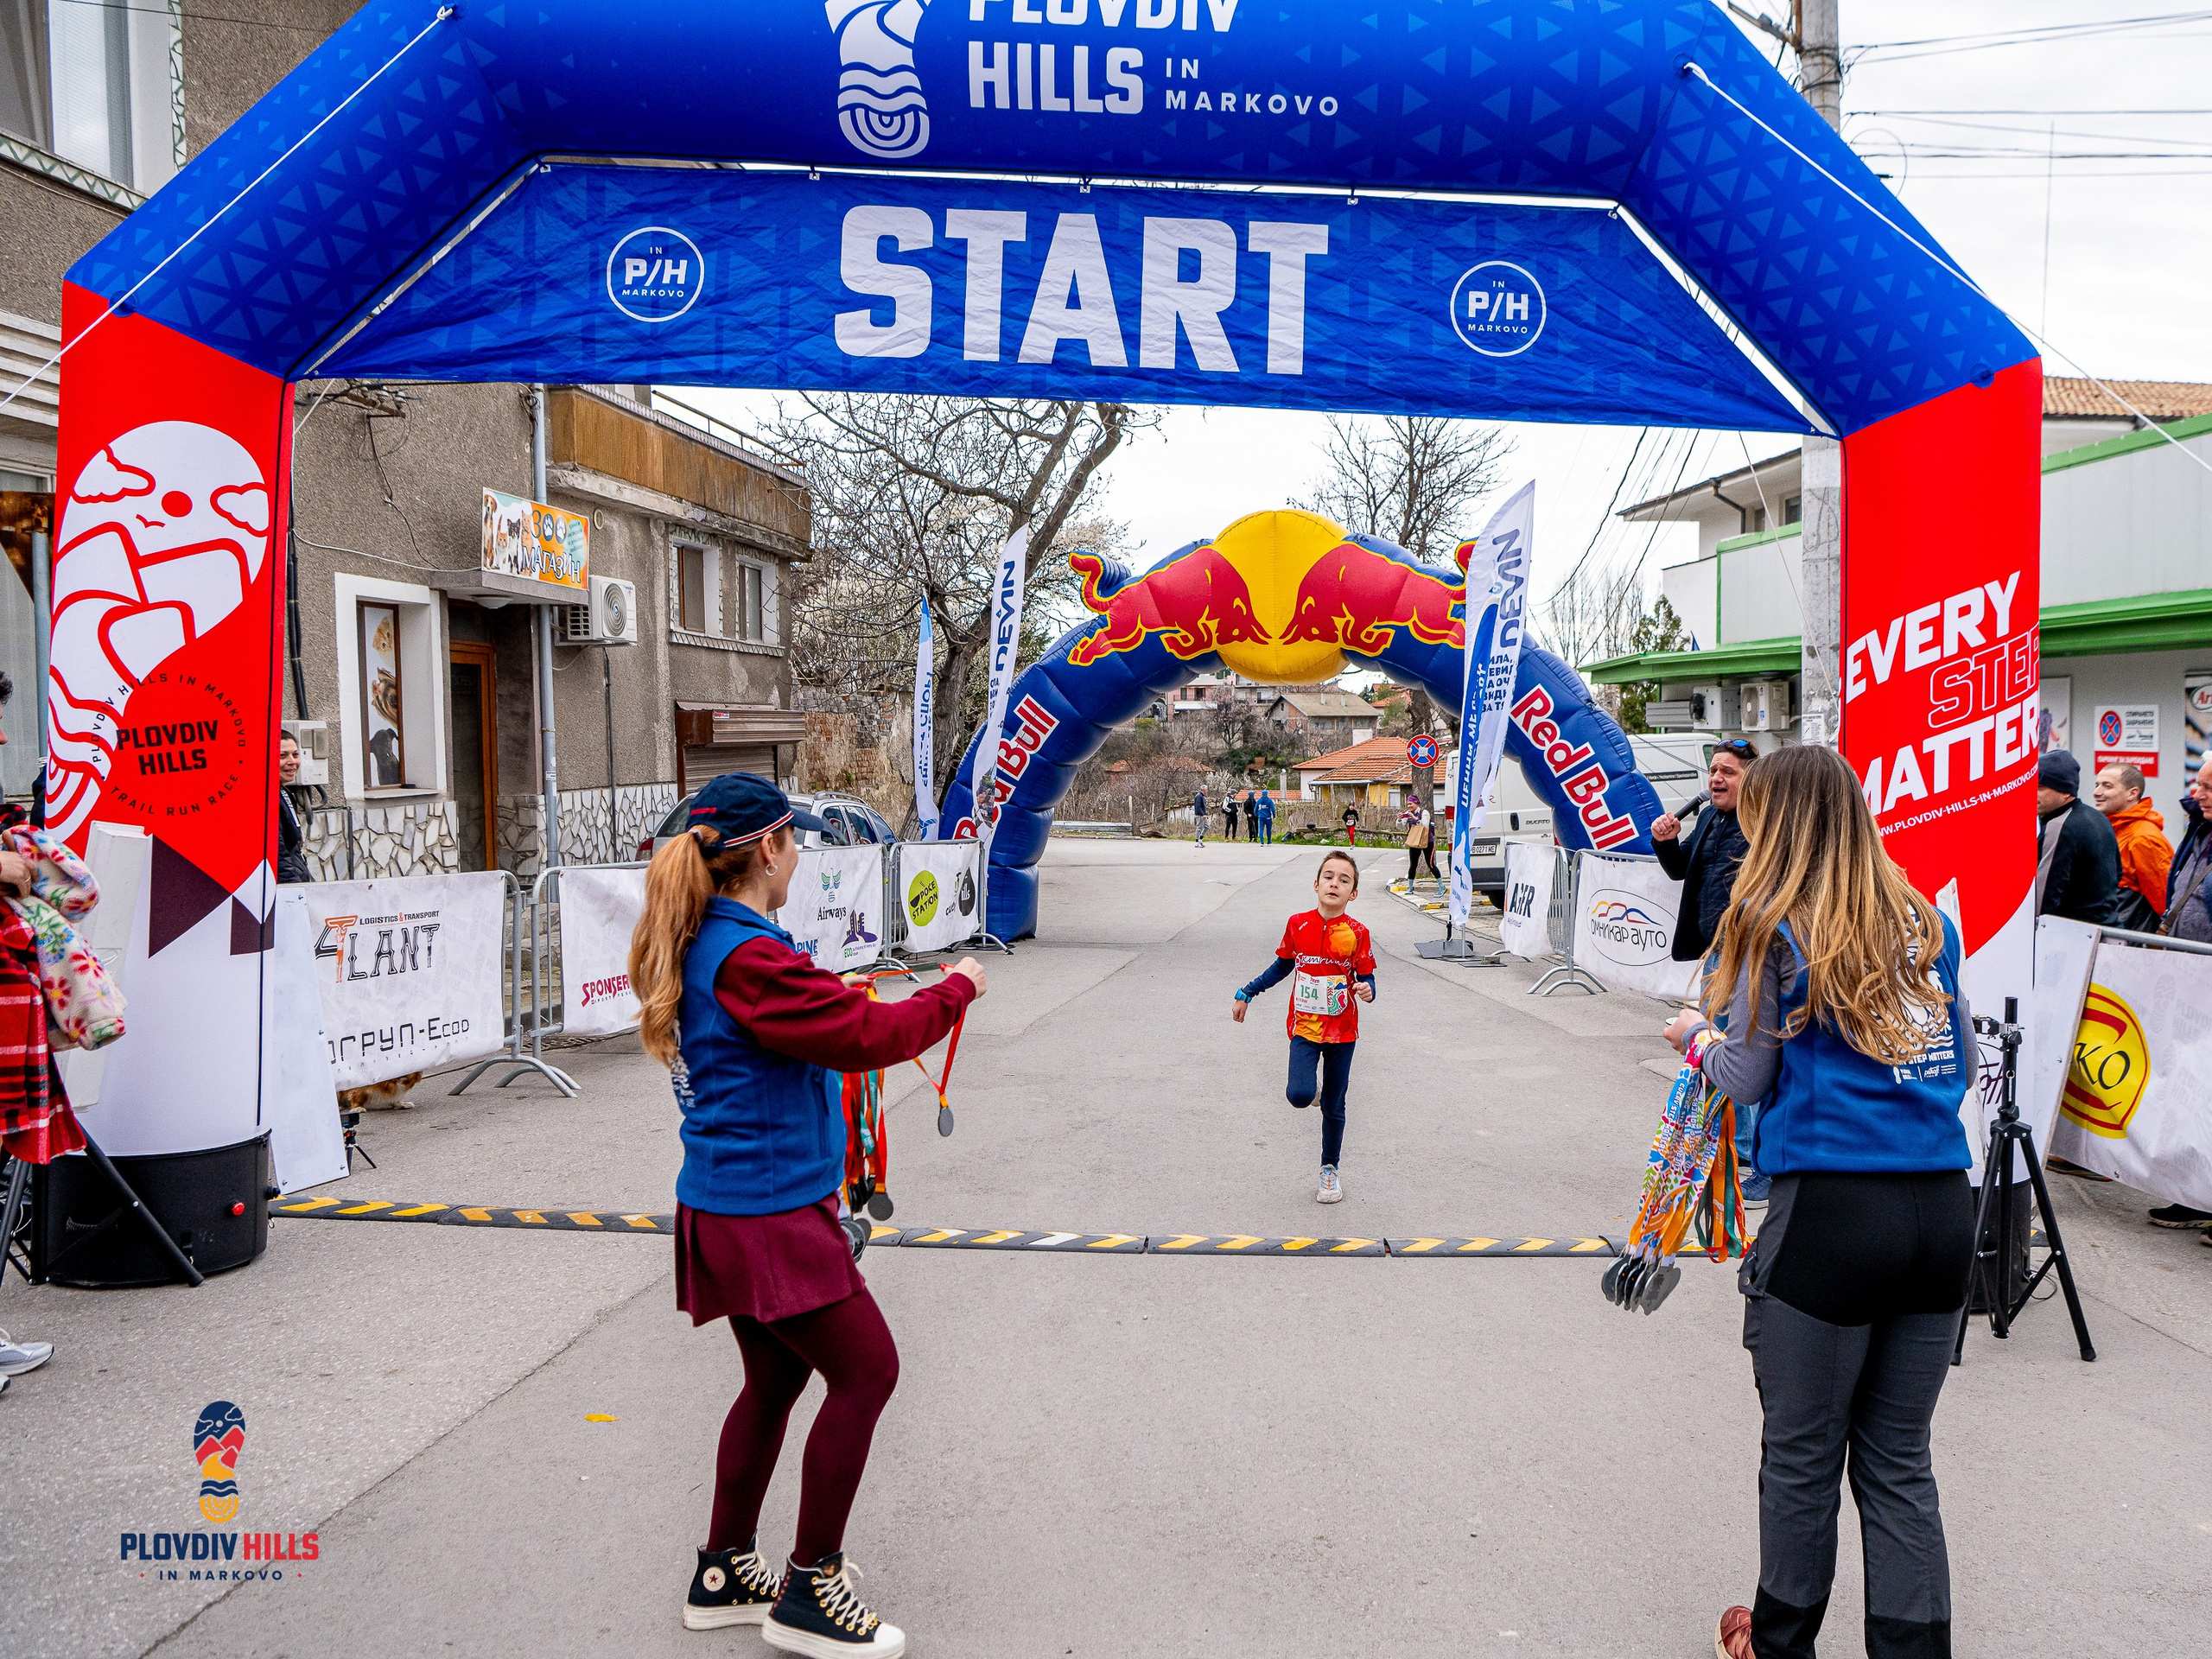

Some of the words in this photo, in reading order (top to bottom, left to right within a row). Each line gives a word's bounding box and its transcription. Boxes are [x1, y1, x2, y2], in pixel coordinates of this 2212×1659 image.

[968, 41, 1144, 115] HILLS
[1166, 57, 1198, 79] IN
[1165, 89, 1338, 116] MARKOVO
[625, 257, 688, 286] P/H
[621, 289, 684, 298] MARKOVO
[834, 205, 1329, 375] START
[1467, 290, 1529, 322] P/H
[1467, 323, 1529, 334] MARKOVO
[521, 544, 582, 584] МАГАЗИН
[1492, 528, 1524, 649] DEVIN
[995, 560, 1016, 673] DEVIN
[1846, 569, 2021, 705] EVERY
[92, 696, 115, 763] PLOVDIV
[118, 672, 168, 696] HILLS
[178, 674, 197, 685] IN
[204, 683, 246, 747] MARKOVO
[1510, 687, 1591, 773] Red
[115, 720, 218, 751] PLOVDIV
[996, 698, 1058, 778] Bull
[137, 748, 207, 776] HILLS
[111, 785, 155, 816] TRAIL
[166, 803, 200, 817] RUN
[207, 773, 238, 805] RACE
[1566, 766, 1636, 851] Bull
[919, 880, 937, 899] POKE
[359, 915, 398, 925] LOGISTICS
[404, 910, 440, 921] TRANSPORT
[817, 906, 847, 921] Airways
[912, 893, 938, 920] STATION
[581, 974, 631, 1007] SPONSER
[1300, 984, 1319, 1001] 154
[2075, 1041, 2132, 1091] KO
